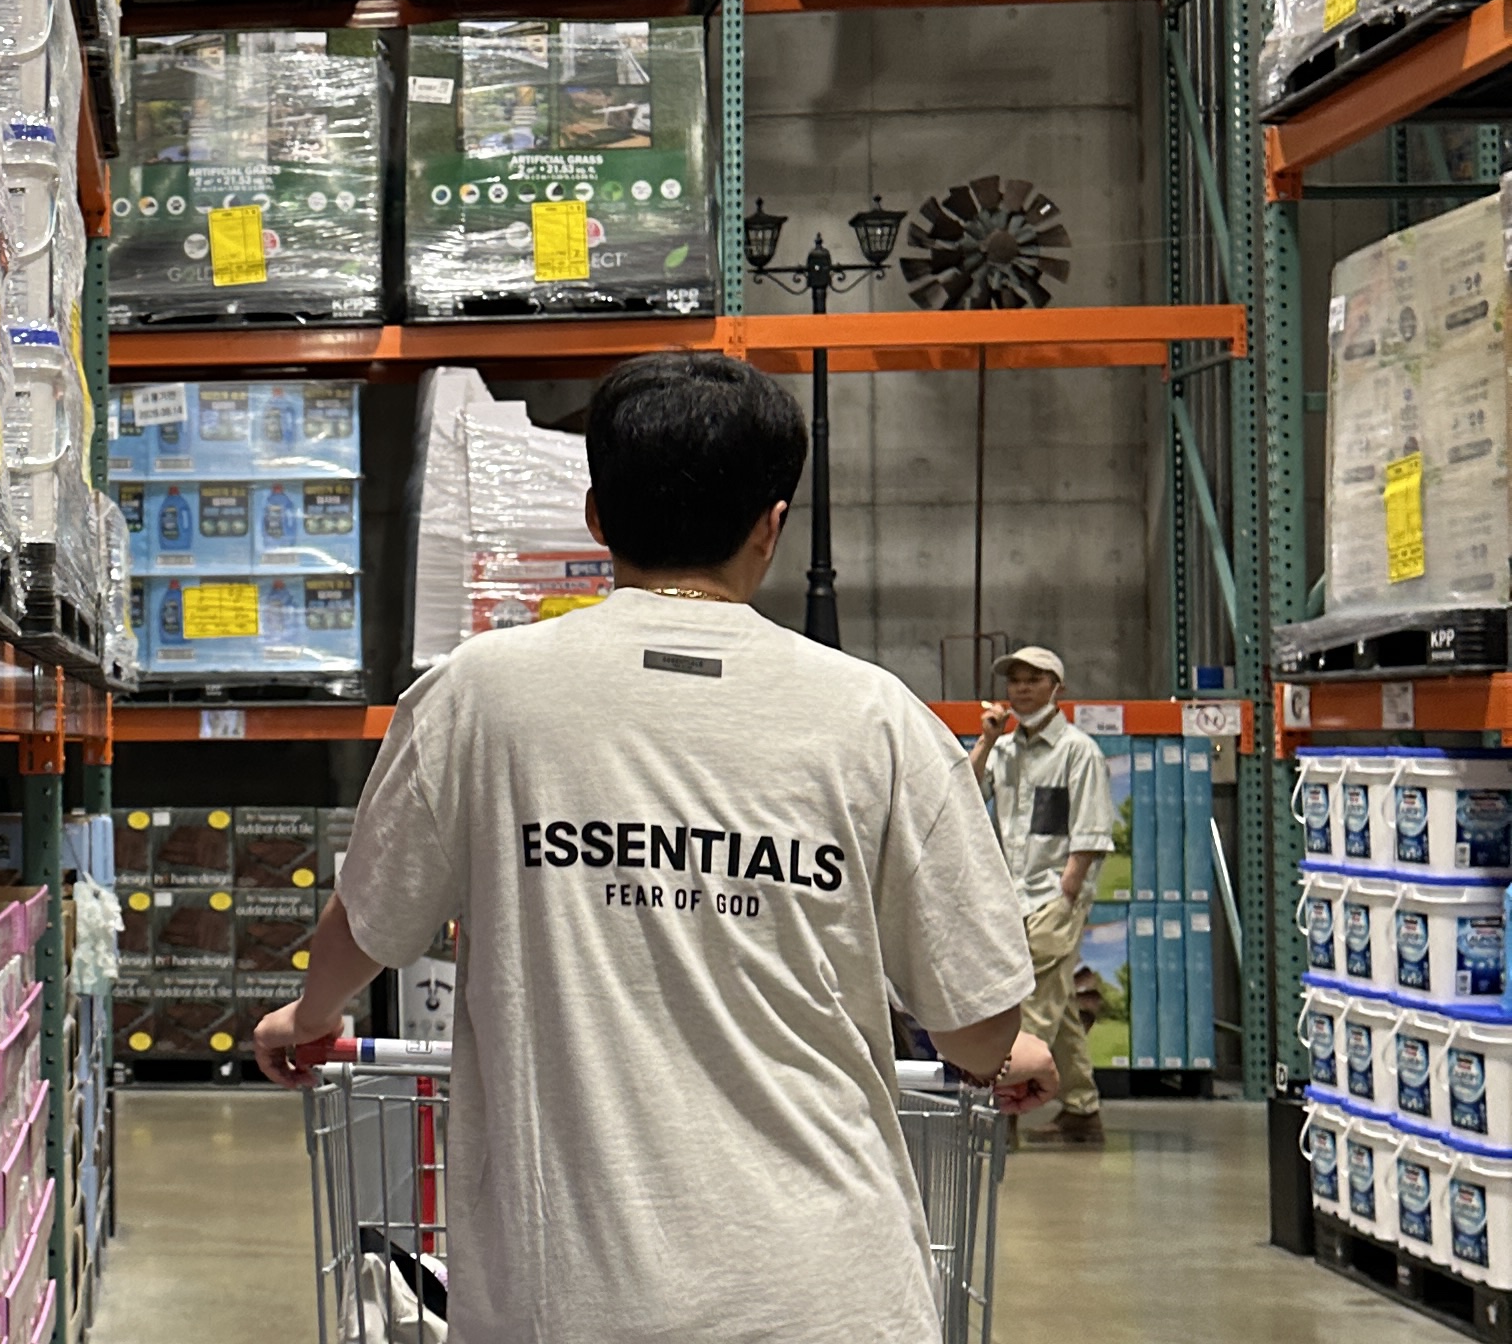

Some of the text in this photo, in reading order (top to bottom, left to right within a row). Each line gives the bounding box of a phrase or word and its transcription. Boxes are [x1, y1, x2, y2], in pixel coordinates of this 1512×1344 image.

[510, 155, 604, 165] ARTIFICIAL GRASS
[188, 167, 243, 177] ARTIFICIAL
[331, 299, 365, 311] KPP
[1430, 628, 1455, 648] KPP
[521, 819, 845, 893] ESSENTIALS
[605, 884, 760, 918] FEAR OF GOD
